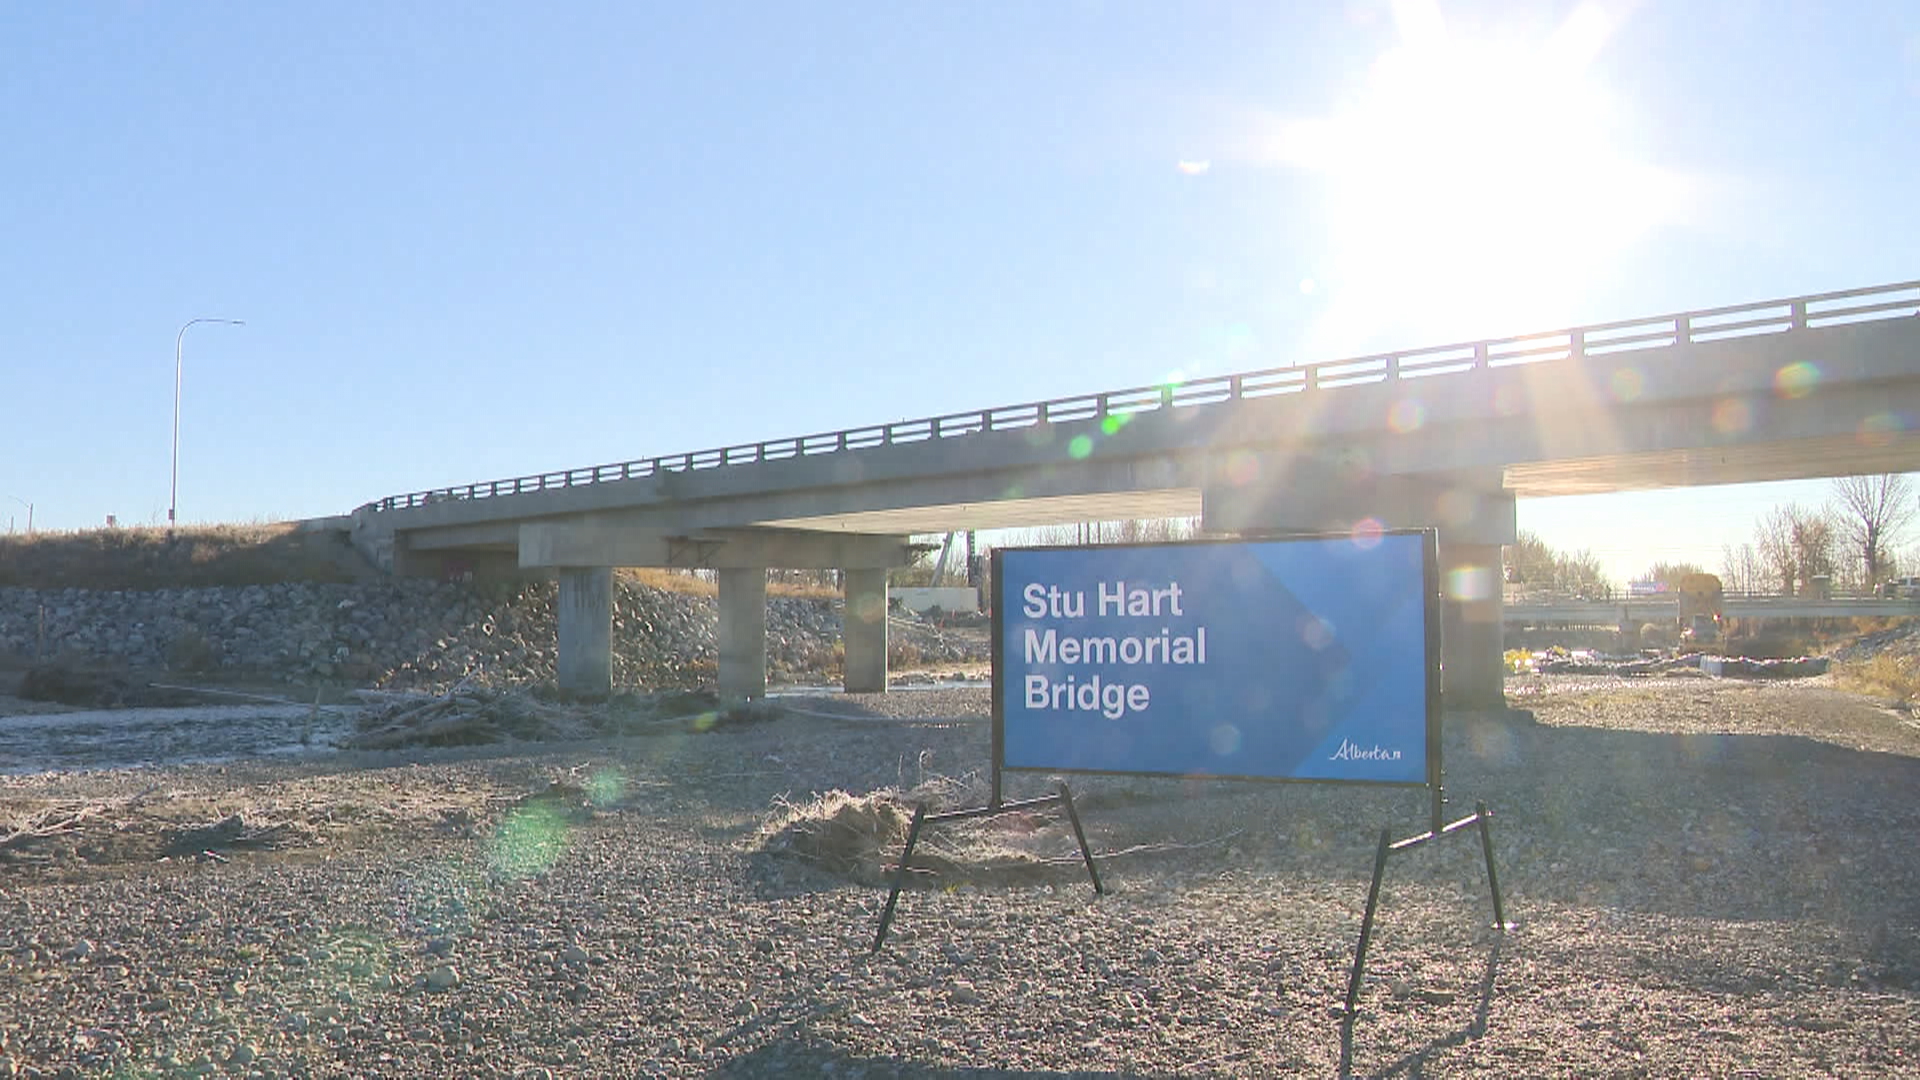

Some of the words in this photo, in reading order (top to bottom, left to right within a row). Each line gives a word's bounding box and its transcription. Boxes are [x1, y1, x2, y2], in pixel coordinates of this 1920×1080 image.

[1023, 582, 1085, 619] Stu
[1098, 581, 1183, 617] Hart
[1024, 627, 1207, 664] Memorial
[1024, 674, 1151, 720] Bridge
